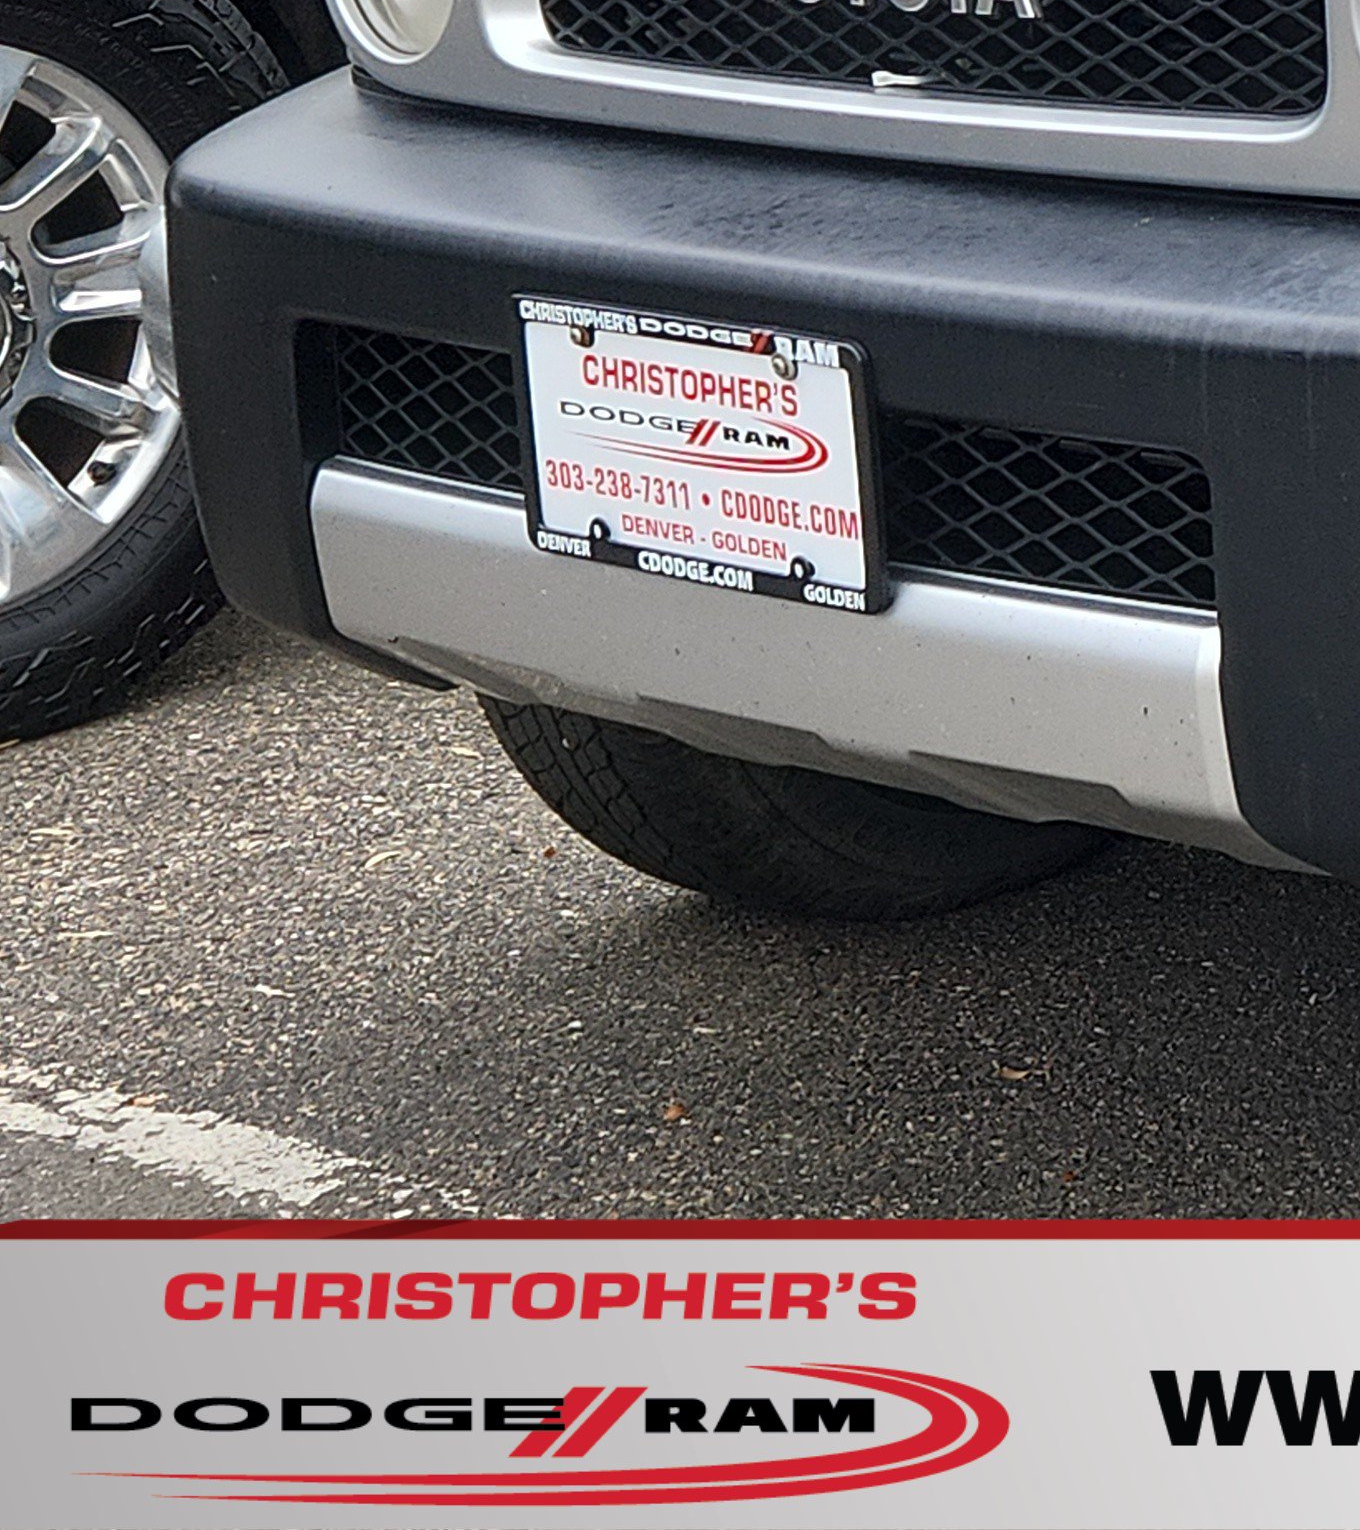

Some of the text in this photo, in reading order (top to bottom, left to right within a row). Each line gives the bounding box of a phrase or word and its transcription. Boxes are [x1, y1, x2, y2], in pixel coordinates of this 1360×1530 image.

[519, 299, 840, 368] CHRISTOPHER'S DODGE RAM
[582, 354, 798, 418] CHRISTOPHER'S
[559, 400, 791, 451] DODGE RAM
[545, 458, 860, 541] 303-238-7311 CDODGE.COM
[536, 529, 866, 612] DENVER CDODGE.COM GOLDEN
[621, 513, 694, 545] DENVER
[712, 530, 787, 562] GOLDEN
